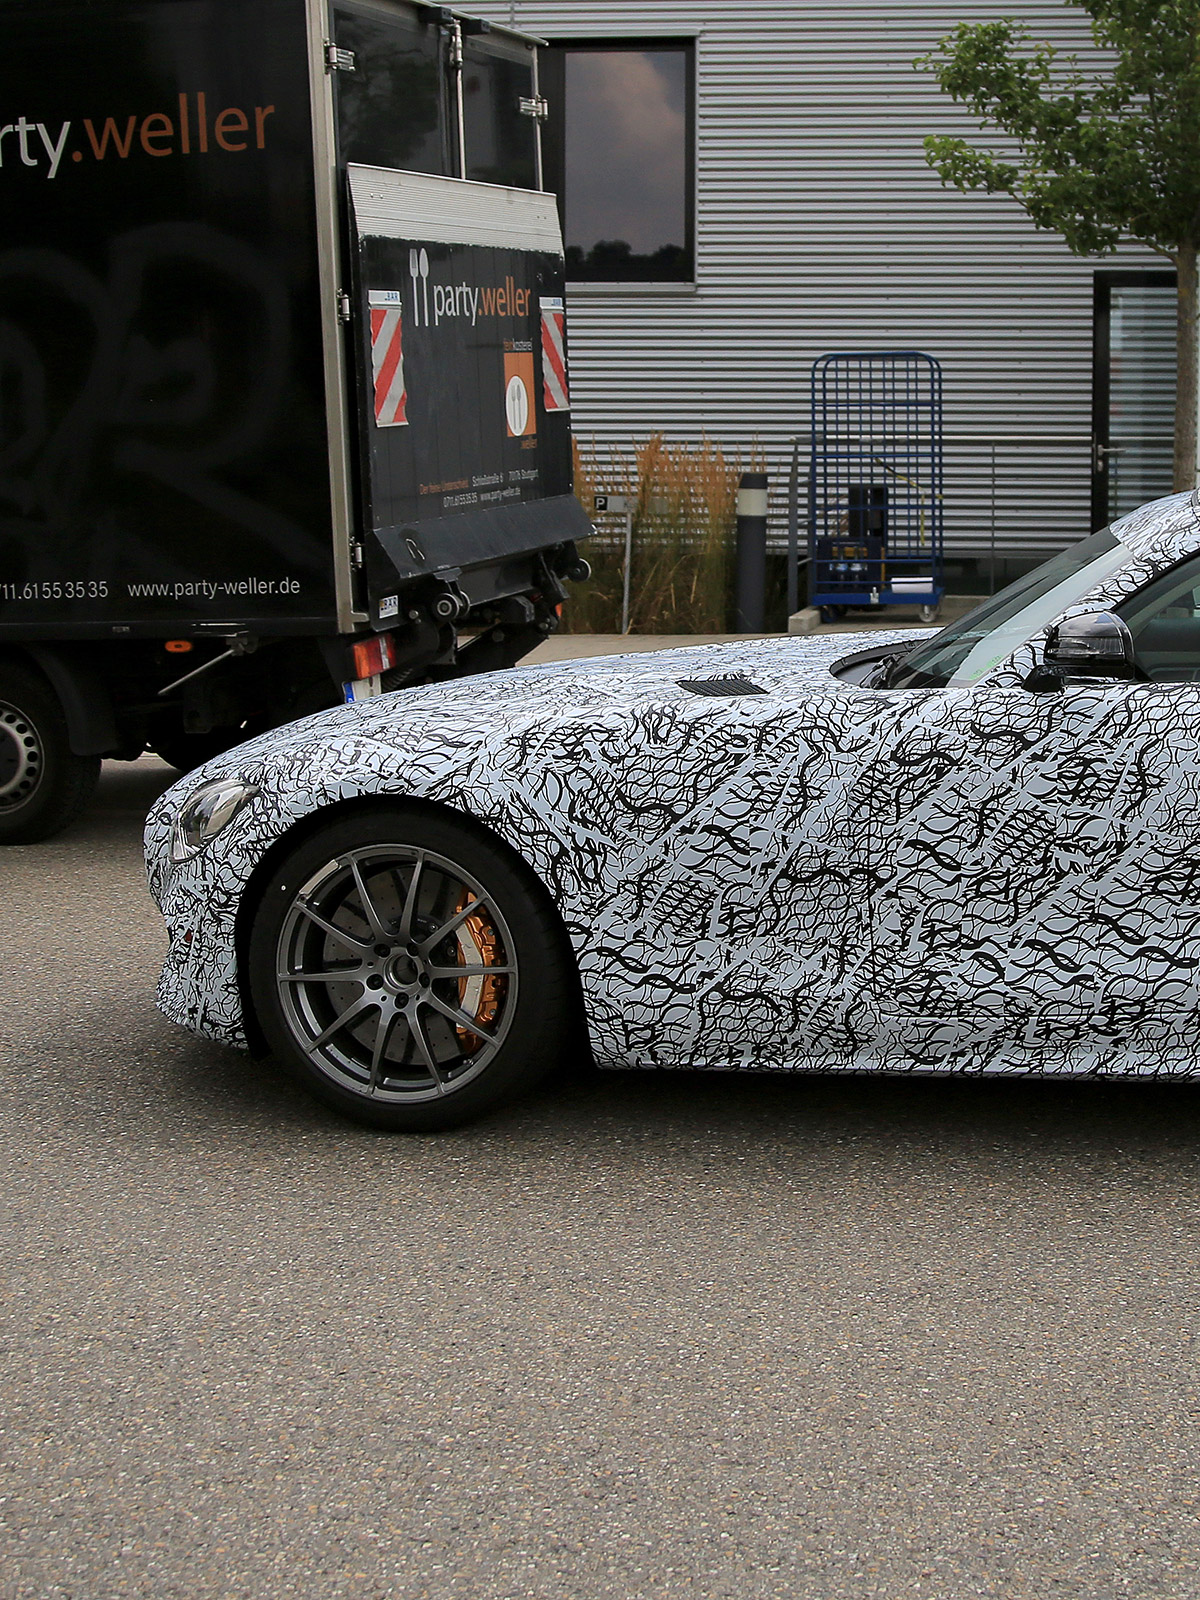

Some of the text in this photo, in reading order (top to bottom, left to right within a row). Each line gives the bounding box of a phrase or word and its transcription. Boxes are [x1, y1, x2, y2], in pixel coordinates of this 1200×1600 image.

[433, 275, 531, 326] party.weller
[596, 497, 606, 509] P
[127, 577, 301, 600] www.party-weller.de
